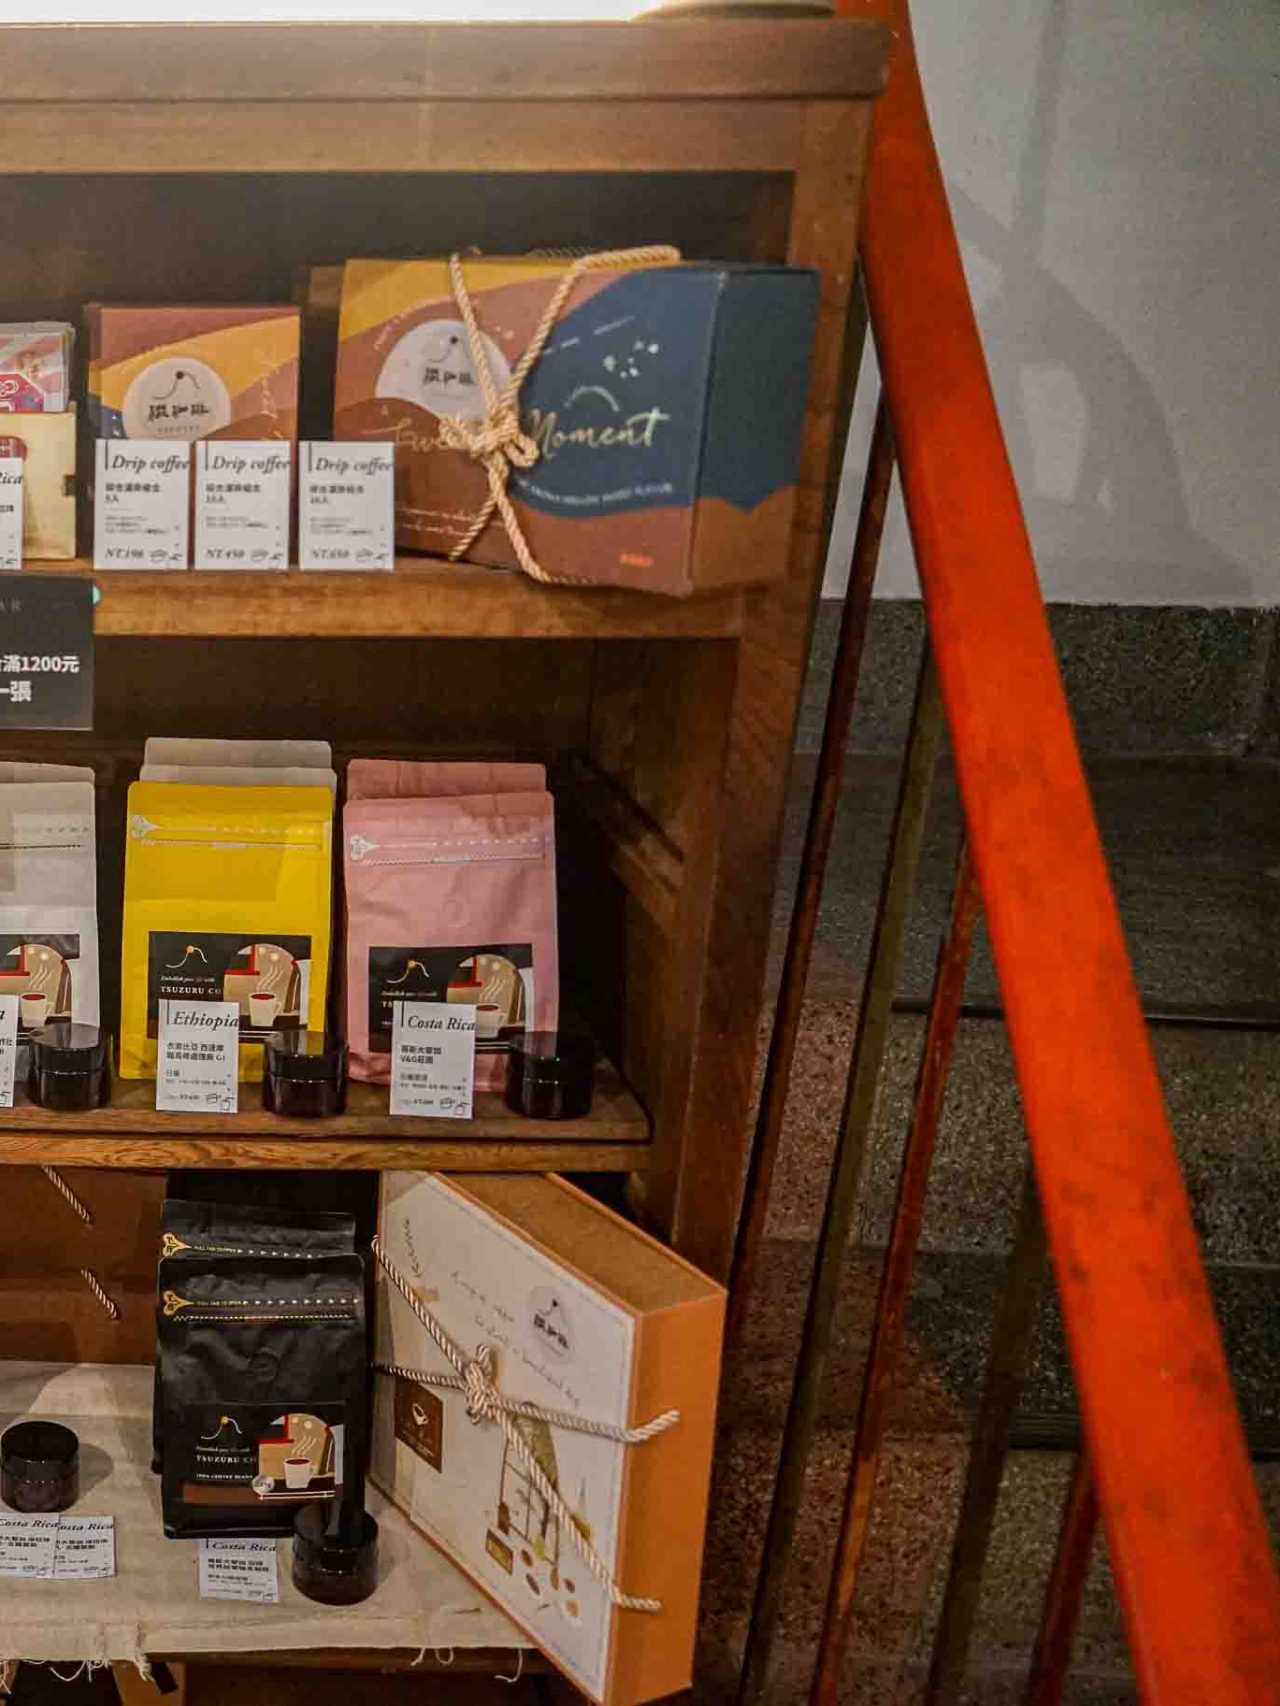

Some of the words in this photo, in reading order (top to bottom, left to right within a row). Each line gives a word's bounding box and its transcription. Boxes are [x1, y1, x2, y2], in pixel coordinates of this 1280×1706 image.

[112, 455, 147, 474] Drip
[149, 455, 190, 474] coffee
[213, 455, 247, 474] Drip
[250, 455, 290, 474] coffee
[315, 457, 349, 476] Drip
[352, 457, 393, 476] coffee
[160, 986, 205, 995] TSUZURU
[173, 1010, 239, 1031] Ethiopia
[408, 1015, 442, 1030] Costa
[447, 1017, 476, 1031] Rica
[32, 1519, 60, 1529] Rica
[57, 1522, 84, 1532] osta
[88, 1522, 114, 1531] Rica
[212, 1541, 246, 1551] Costa
[250, 1543, 277, 1552] Rica
